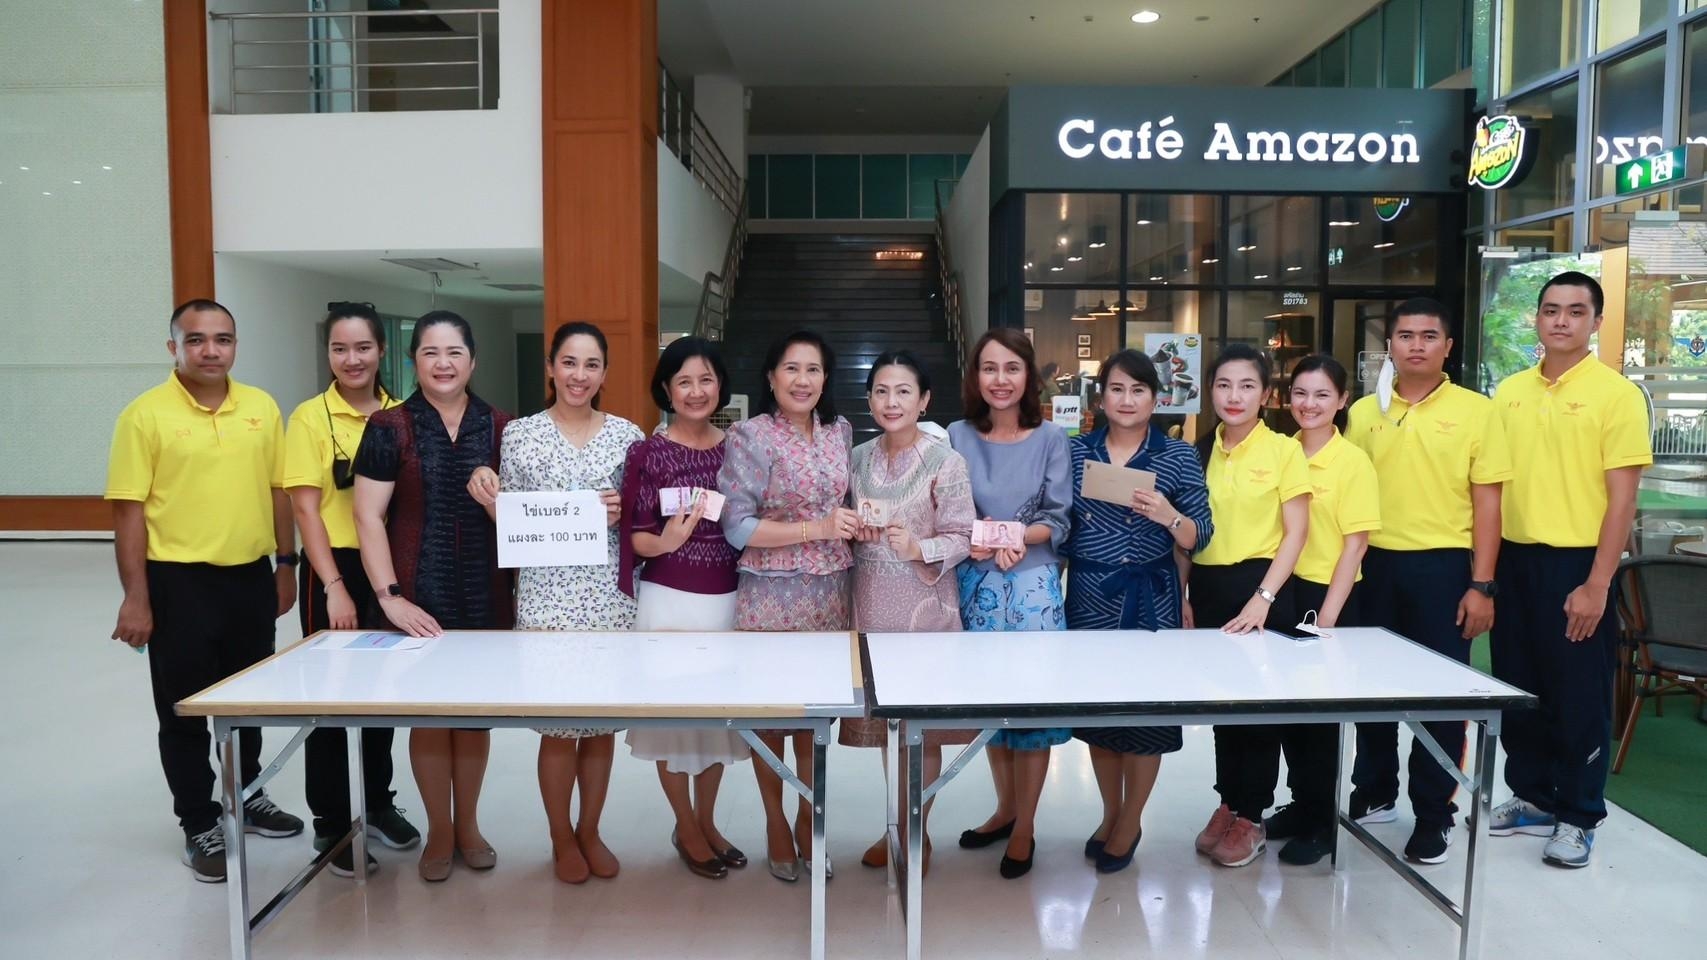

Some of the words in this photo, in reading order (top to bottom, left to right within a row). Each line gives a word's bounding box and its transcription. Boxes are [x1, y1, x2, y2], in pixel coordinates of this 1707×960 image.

[1058, 116, 1184, 159] Café
[1204, 122, 1420, 163] Amazon
[522, 501, 570, 517] ไข่เบอร์
[574, 506, 580, 516] 2
[508, 533, 545, 543] แผงละ
[551, 532, 569, 542] 100
[574, 531, 598, 542] บาท
